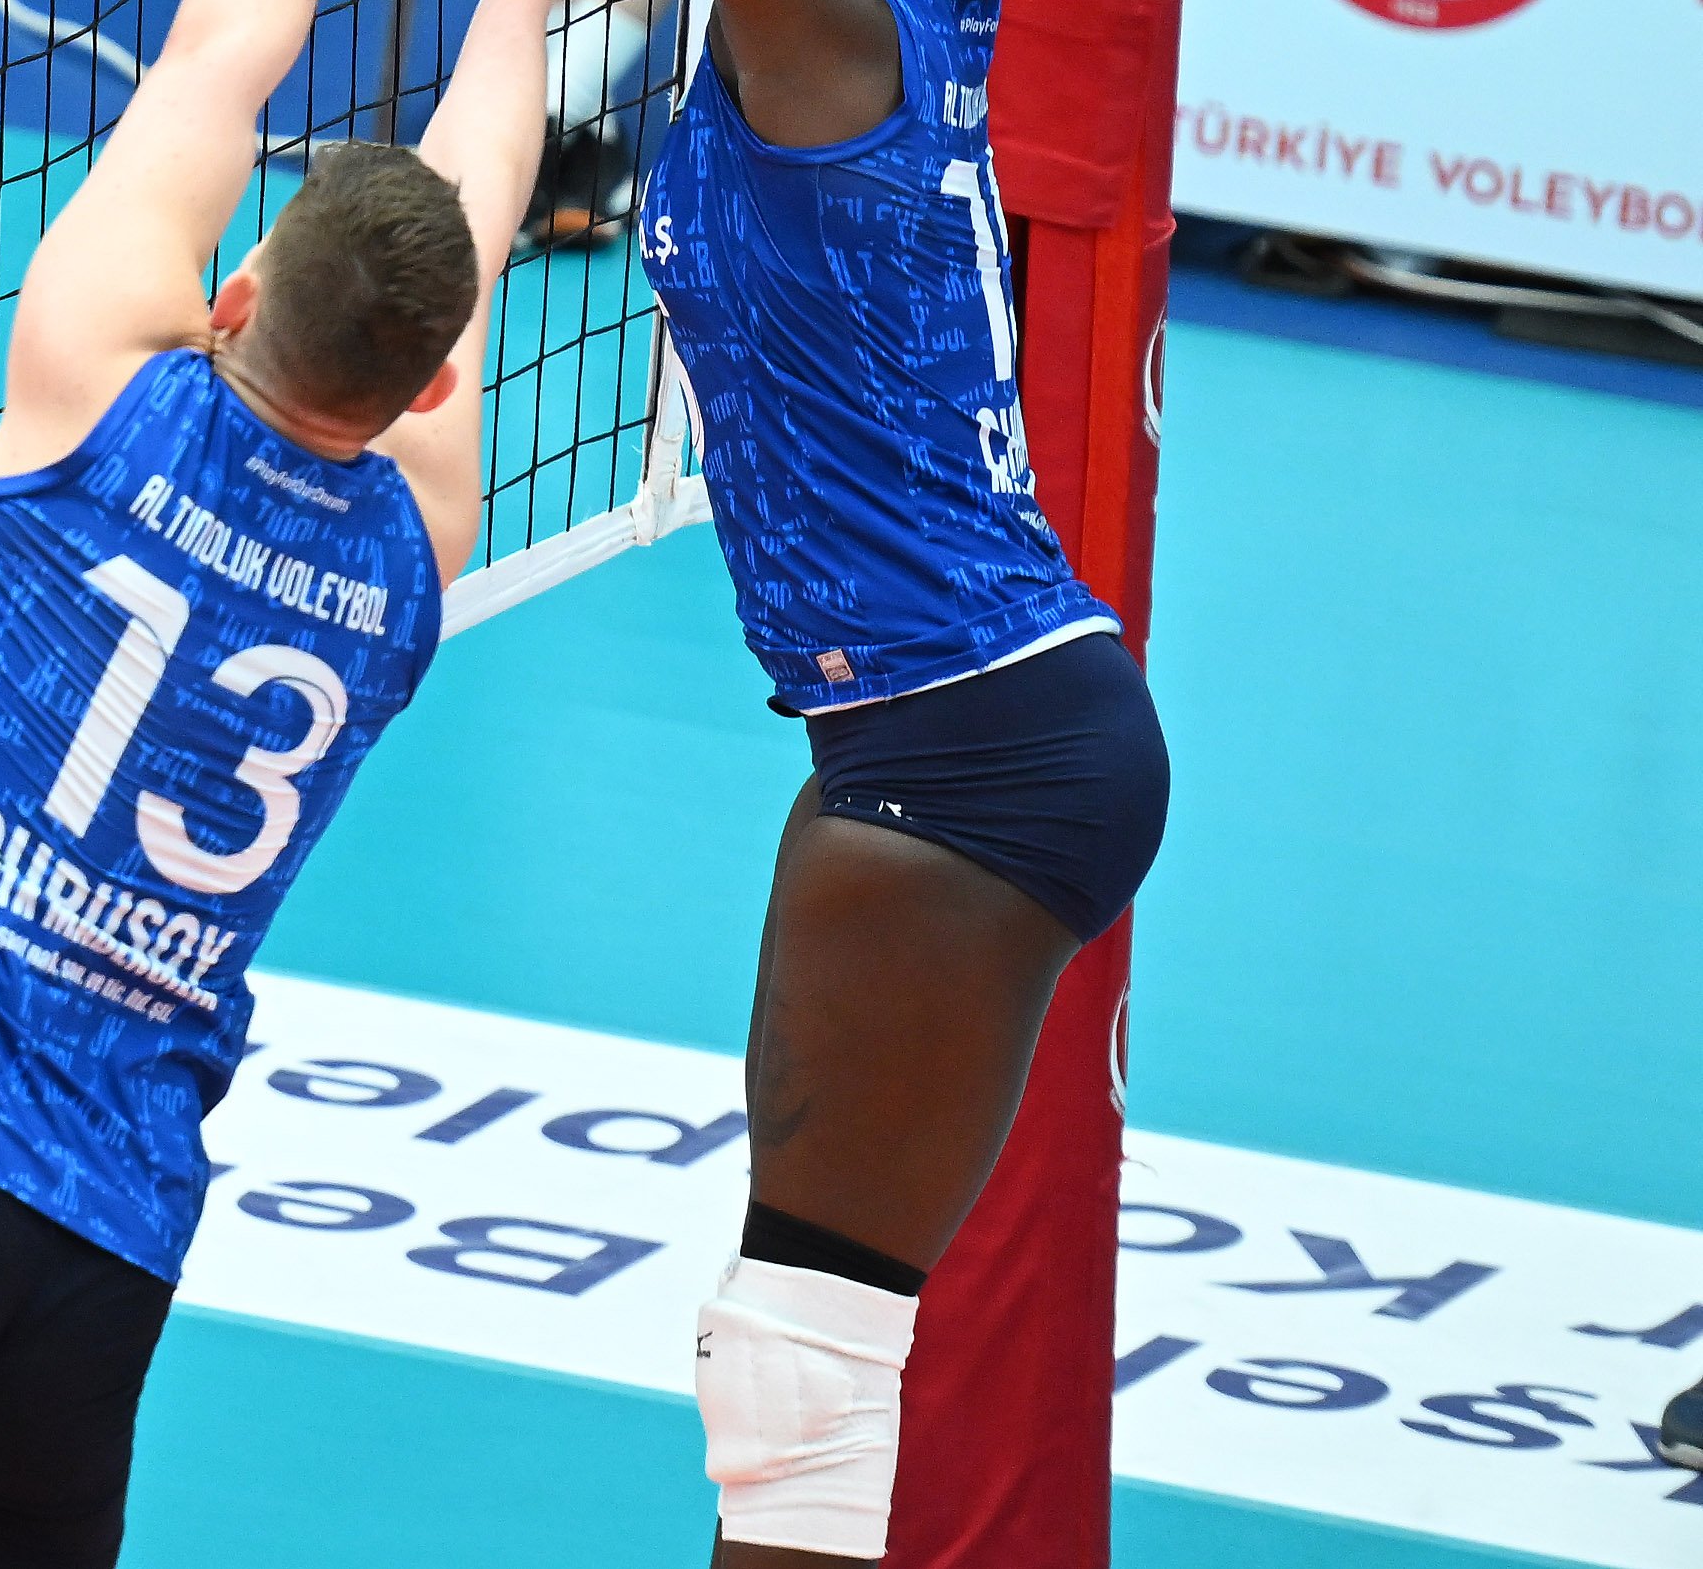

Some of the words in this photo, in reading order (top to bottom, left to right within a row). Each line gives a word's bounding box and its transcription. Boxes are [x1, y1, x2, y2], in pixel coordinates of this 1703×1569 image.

[1428, 149, 1703, 242] VOLEYBO
[128, 473, 273, 592] ALTINOLUK
[266, 553, 389, 637] VOLEYBOL
[42, 553, 349, 894] 13
